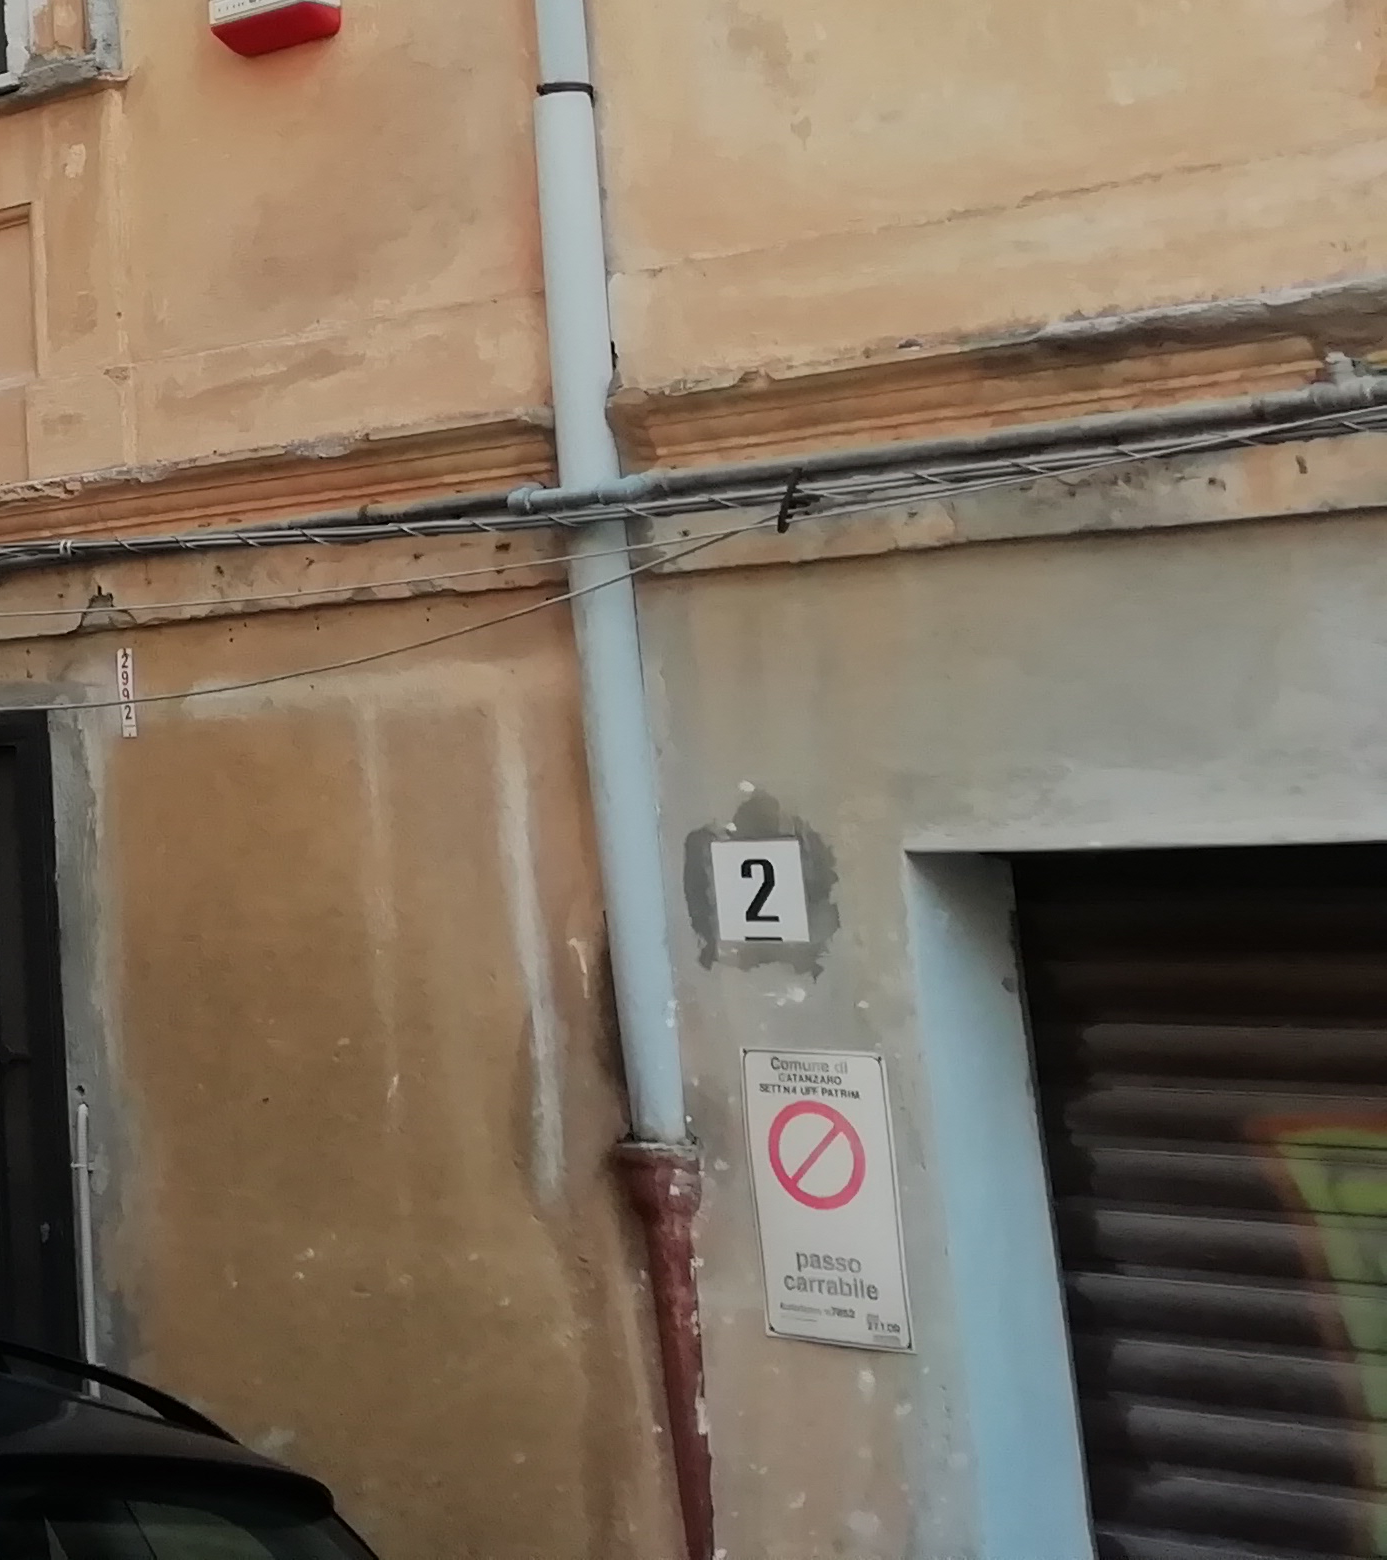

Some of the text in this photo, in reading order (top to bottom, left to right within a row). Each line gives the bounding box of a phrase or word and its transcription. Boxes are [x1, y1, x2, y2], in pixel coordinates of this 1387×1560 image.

[740, 858, 780, 923] 2
[770, 1056, 849, 1075] Comune di
[778, 1072, 843, 1086] CATANZARO
[795, 1251, 862, 1273] passo
[783, 1274, 879, 1301] carrabile
